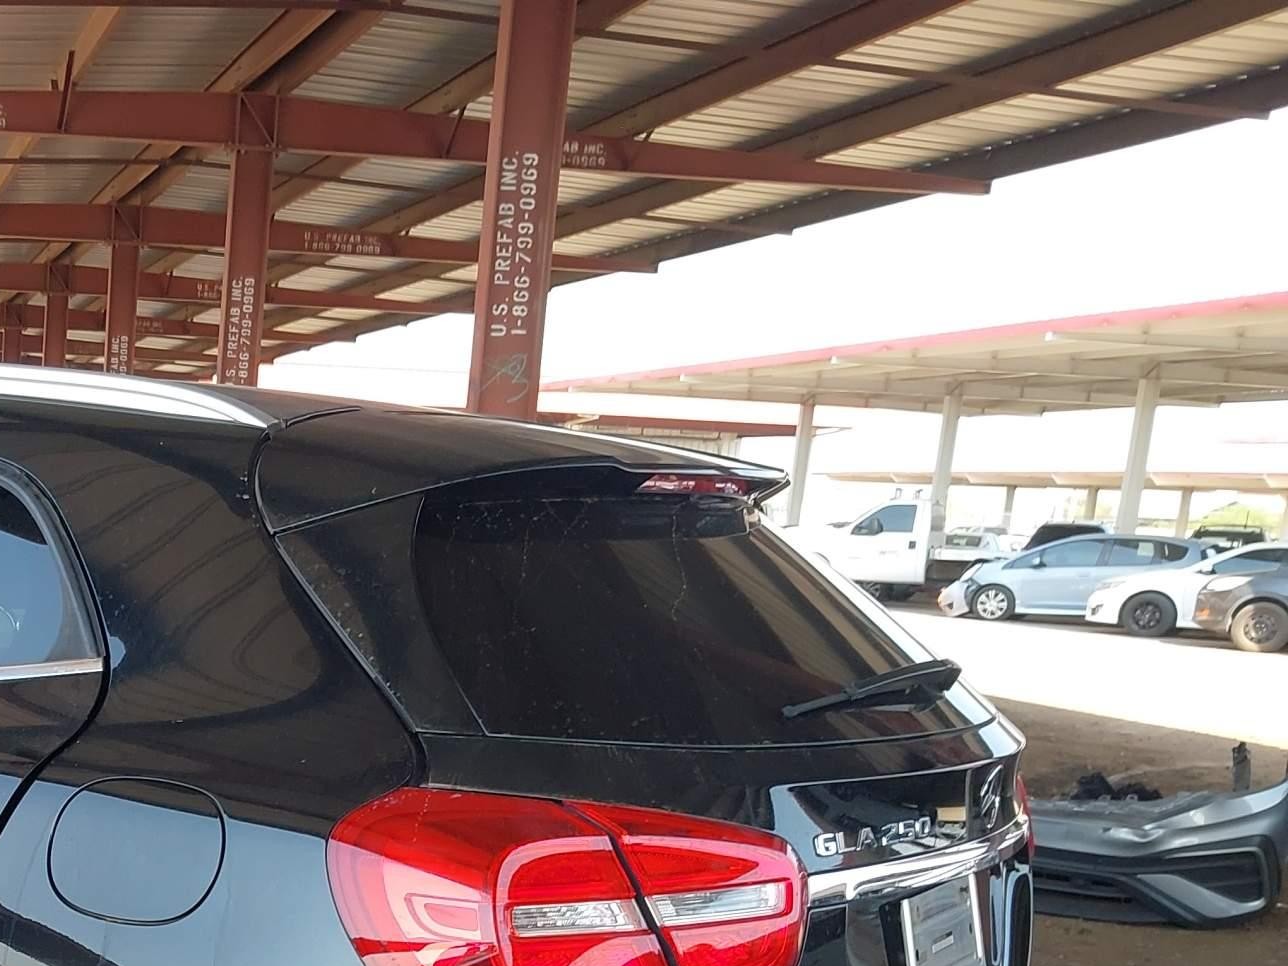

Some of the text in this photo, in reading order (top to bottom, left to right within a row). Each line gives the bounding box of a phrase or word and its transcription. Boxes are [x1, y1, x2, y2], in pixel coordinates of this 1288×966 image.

[490, 151, 519, 337] U.S. PREFAB INC.
[511, 153, 539, 335] 1-866-799-0969
[231, 276, 243, 301] INC.
[226, 307, 241, 358] PREFAB
[238, 278, 255, 385] -866-799-0969
[813, 816, 931, 857] GLA 250
